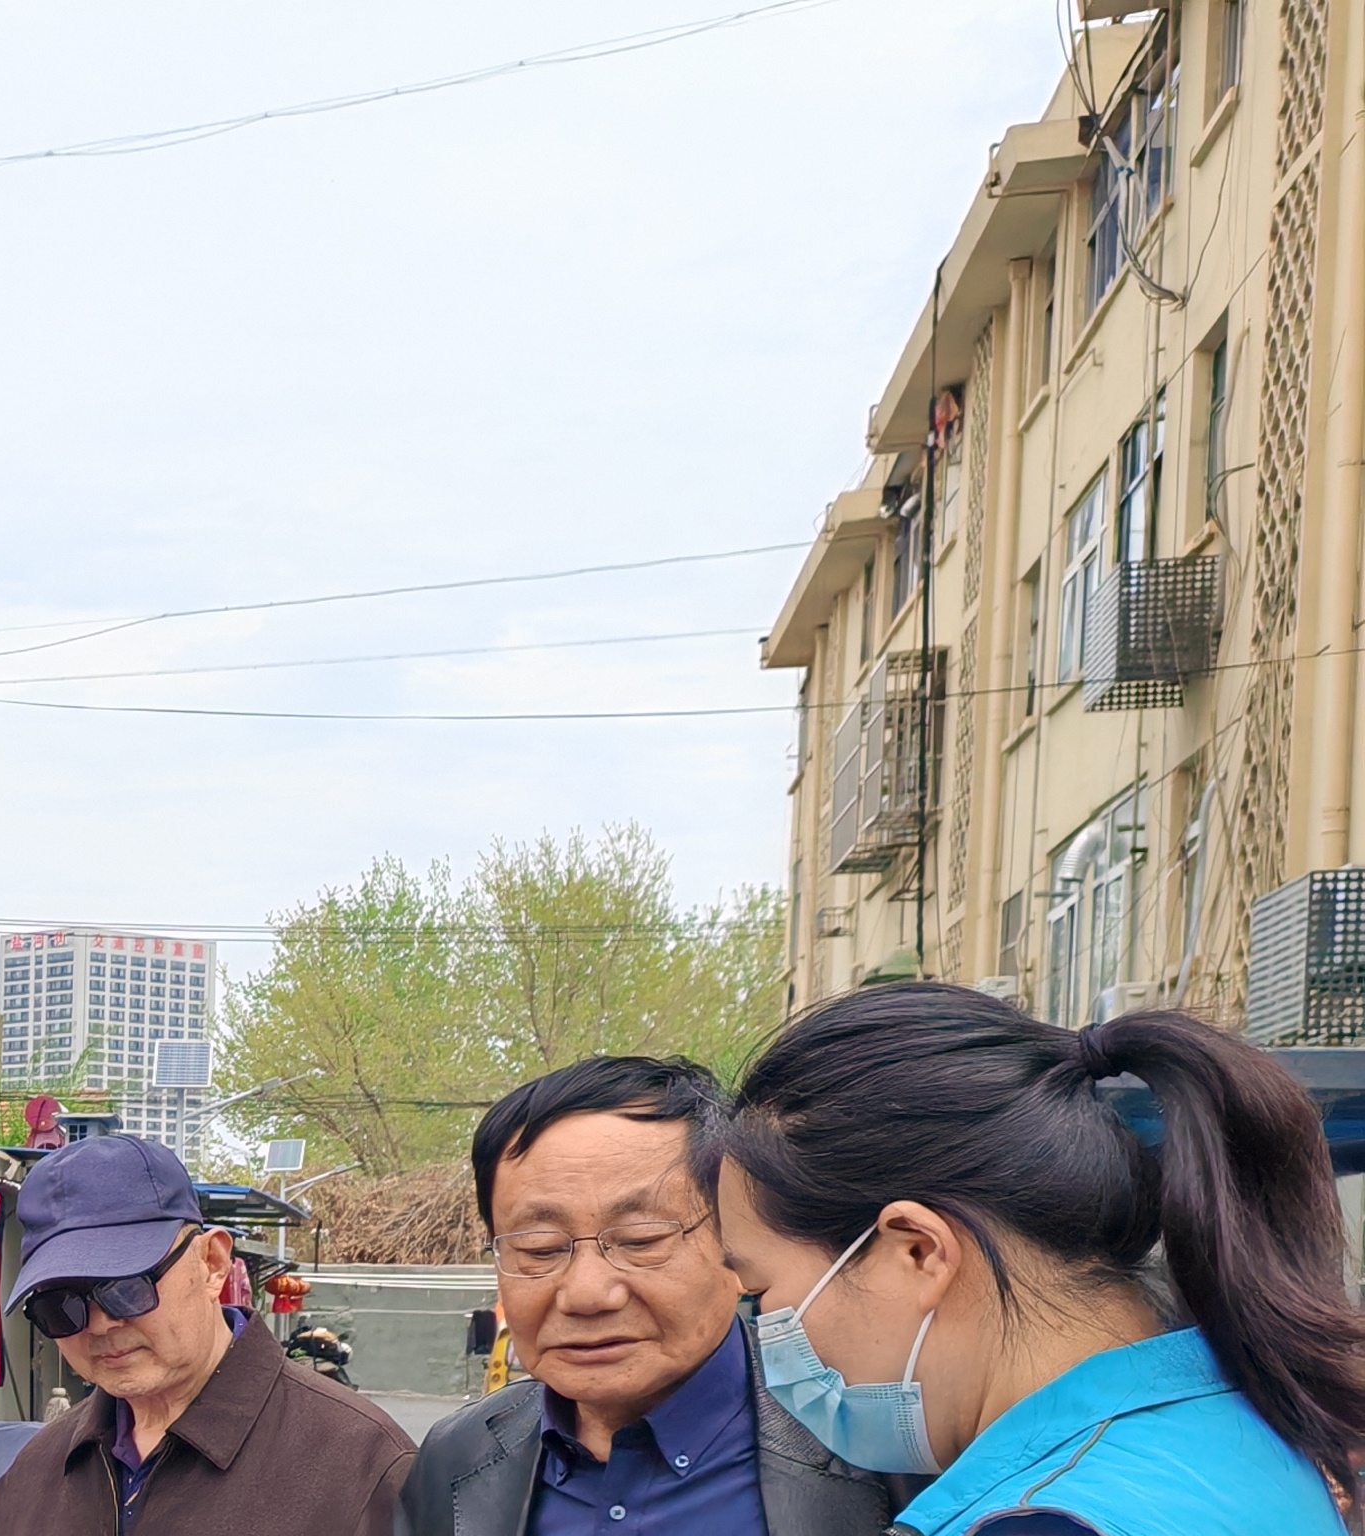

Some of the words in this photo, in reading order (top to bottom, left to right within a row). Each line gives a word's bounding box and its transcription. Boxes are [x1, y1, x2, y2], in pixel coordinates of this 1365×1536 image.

[93, 934, 203, 959] 交通控股集团
